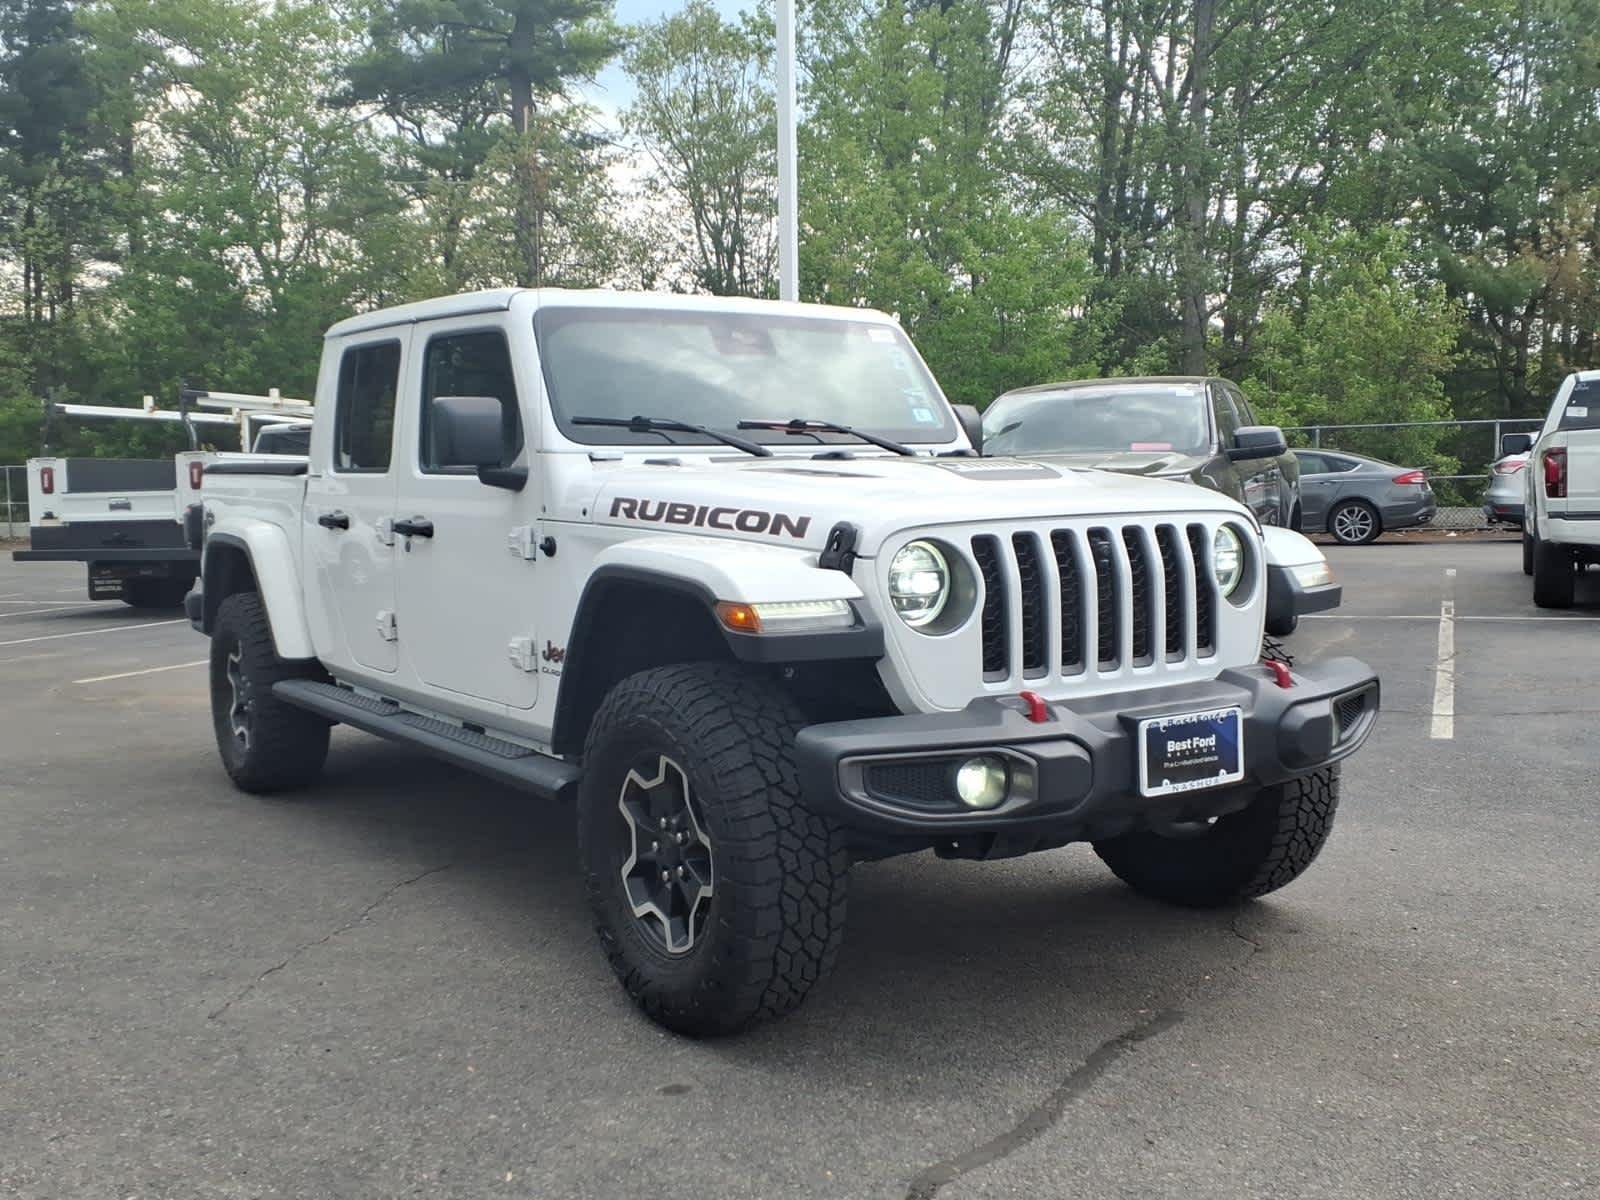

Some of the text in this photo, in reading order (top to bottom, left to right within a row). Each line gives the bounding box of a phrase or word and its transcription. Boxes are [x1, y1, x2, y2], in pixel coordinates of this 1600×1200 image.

[609, 497, 812, 539] RUBICON
[1167, 734, 1216, 752] Best Ford
[1171, 778, 1220, 792] NASHUA
